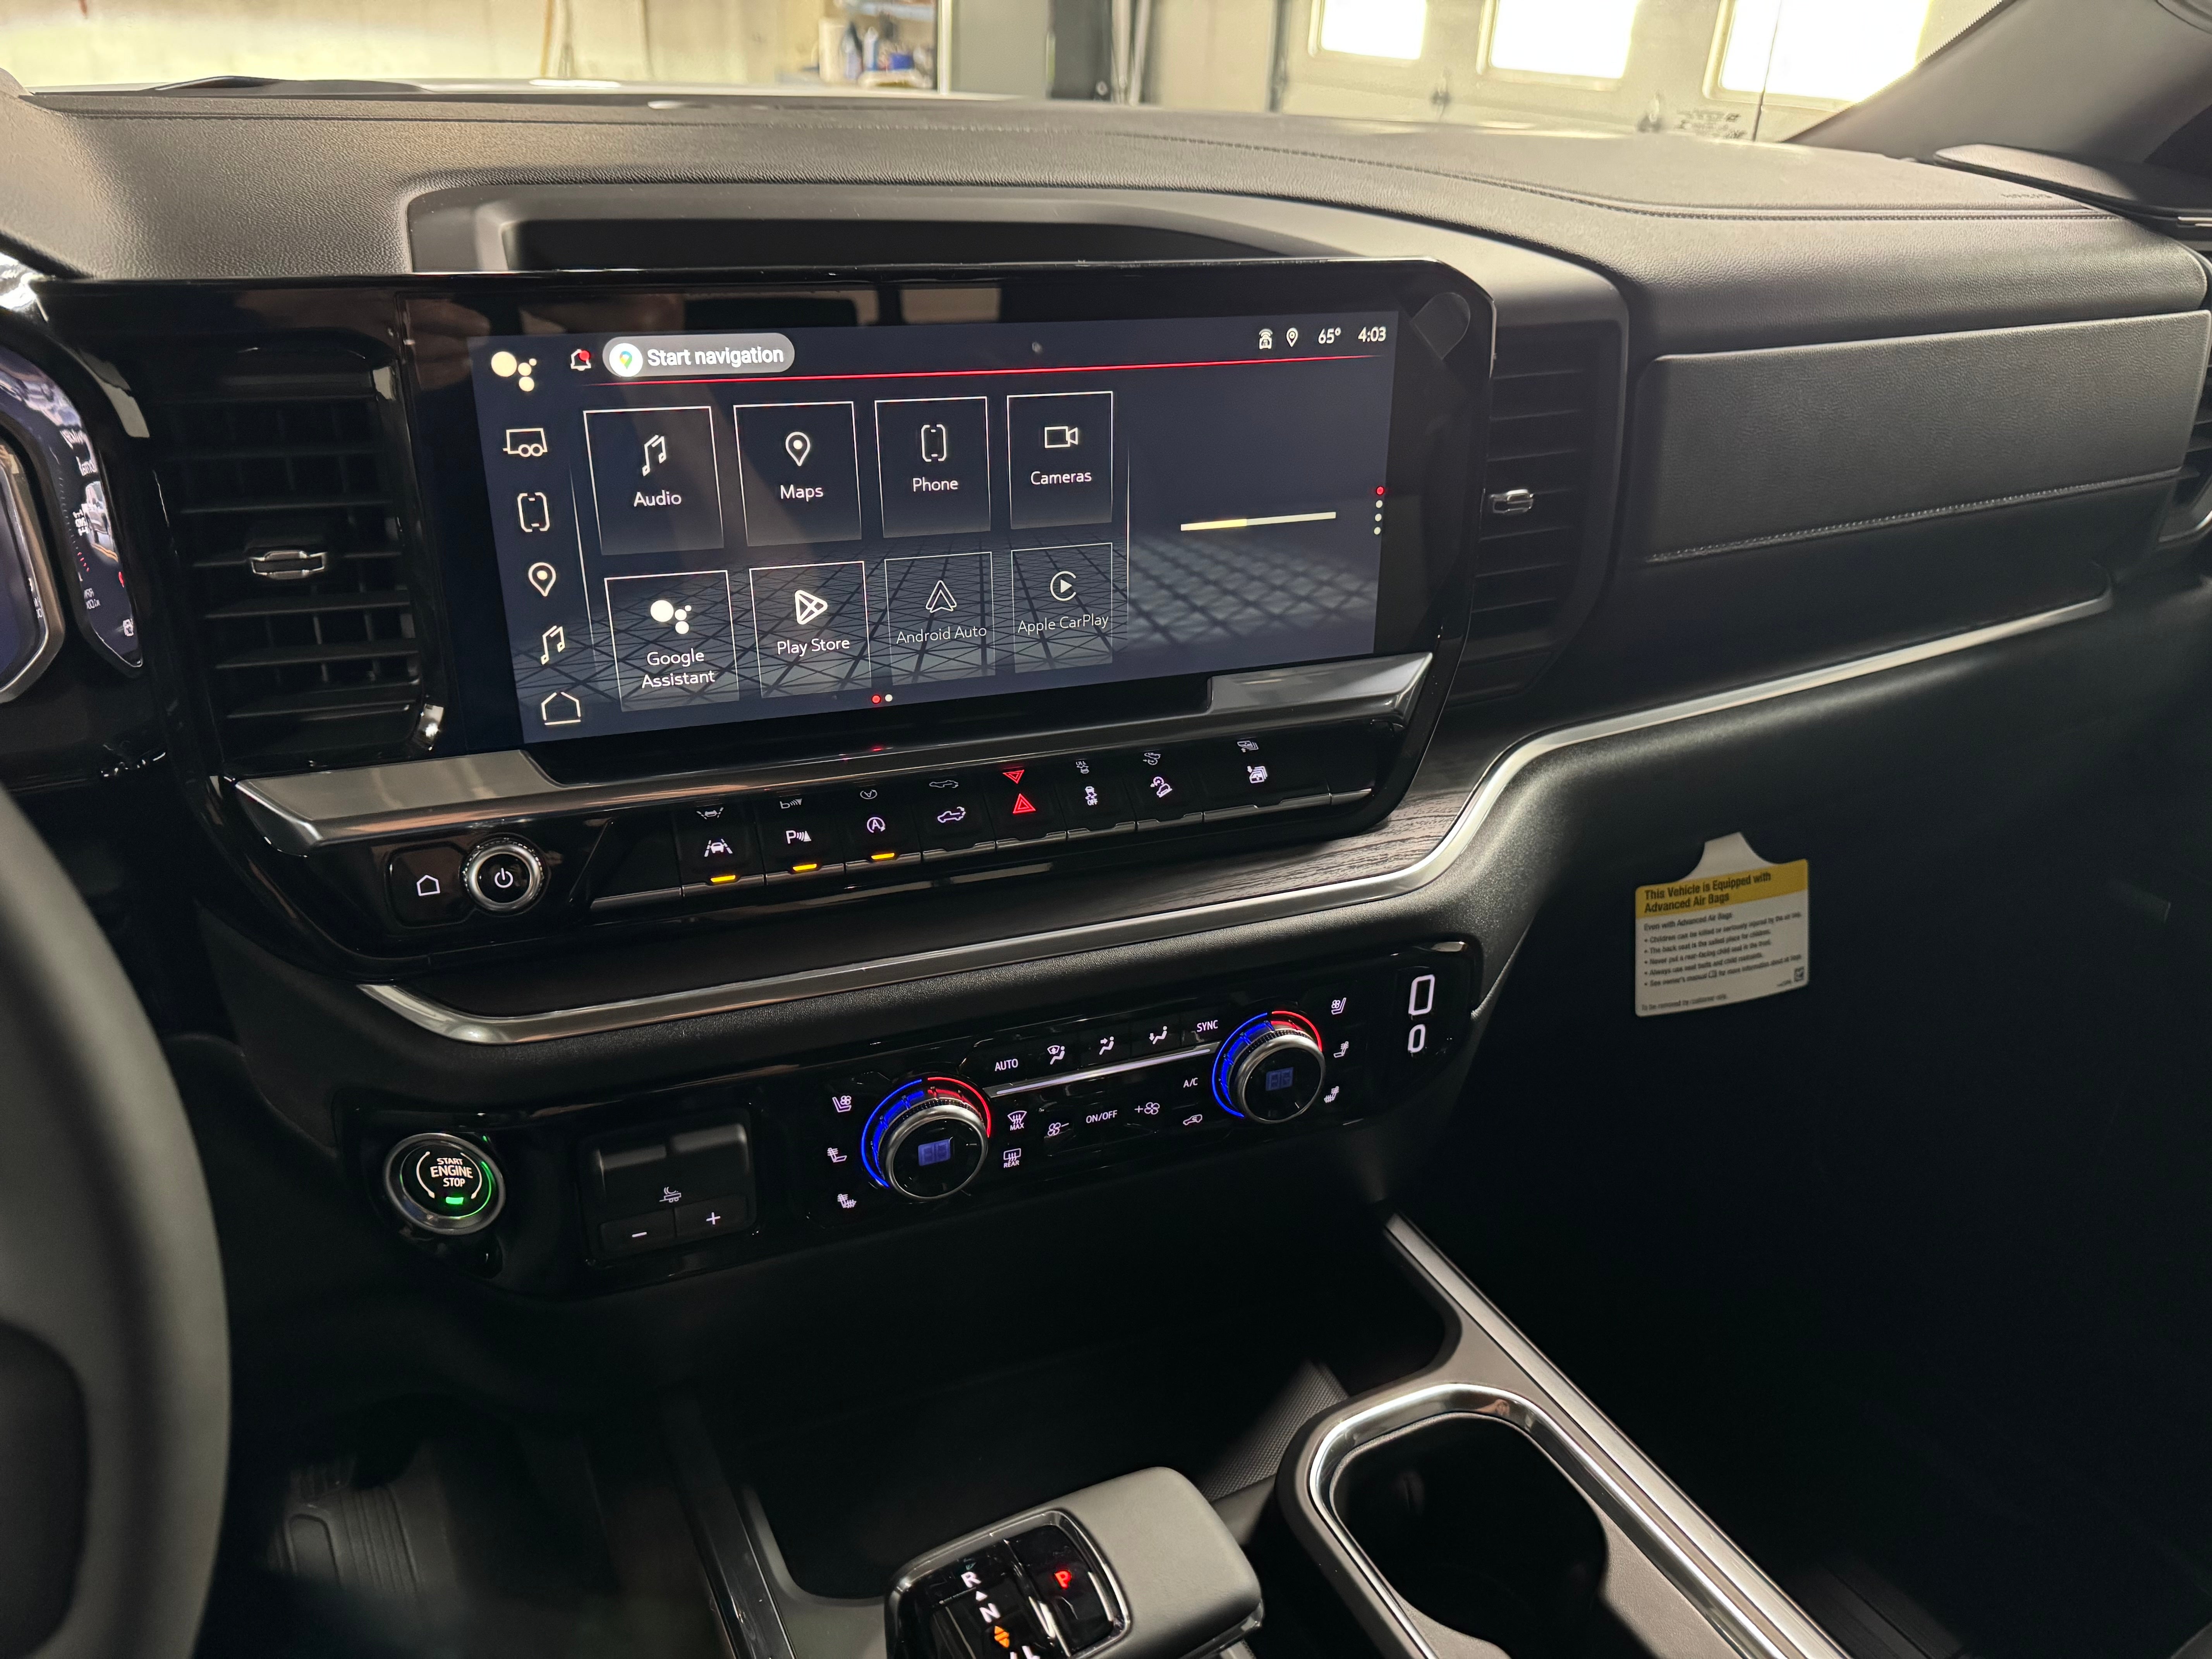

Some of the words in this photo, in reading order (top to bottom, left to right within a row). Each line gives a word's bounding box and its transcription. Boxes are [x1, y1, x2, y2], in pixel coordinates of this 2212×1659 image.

[1357, 326, 1386, 343] 4:03
[647, 348, 692, 367] Start
[694, 345, 784, 368] navigation
[912, 476, 959, 492] Phone
[1030, 471, 1092, 485] Cameras
[633, 489, 682, 507] Audio
[780, 484, 824, 502] Maps
[1017, 619, 1056, 636] Apple
[1059, 613, 1109, 629] CarPlay
[896, 626, 951, 644] Android
[954, 625, 987, 639] Auto
[777, 639, 808, 657] Play
[811, 638, 850, 652] Store
[646, 647, 705, 668] Google
[641, 670, 716, 689] Assistant
[1645, 890, 1664, 900] This
[1668, 884, 1700, 897] Vehicle
[1703, 882, 1710, 891] is
[1712, 875, 1751, 891] Equipped
[1753, 872, 1771, 883] with
[1645, 898, 1690, 913] Advanced
[1693, 896, 1706, 905] Air
[1708, 893, 1729, 904] Bags
[1196, 1019, 1219, 1032] SYNC
[994, 1058, 1019, 1072] AUTO
[1183, 1077, 1199, 1088] A/C
[1085, 1109, 1118, 1124] ON/OFF
[1009, 1123, 1025, 1131] MAX
[430, 1165, 473, 1178] ENGINE
[1003, 1160, 1020, 1169] REAR
[443, 1178, 465, 1187] STOP
[960, 1571, 981, 1588] R
[1054, 1570, 1072, 1589] P
[979, 1602, 1001, 1623] N
